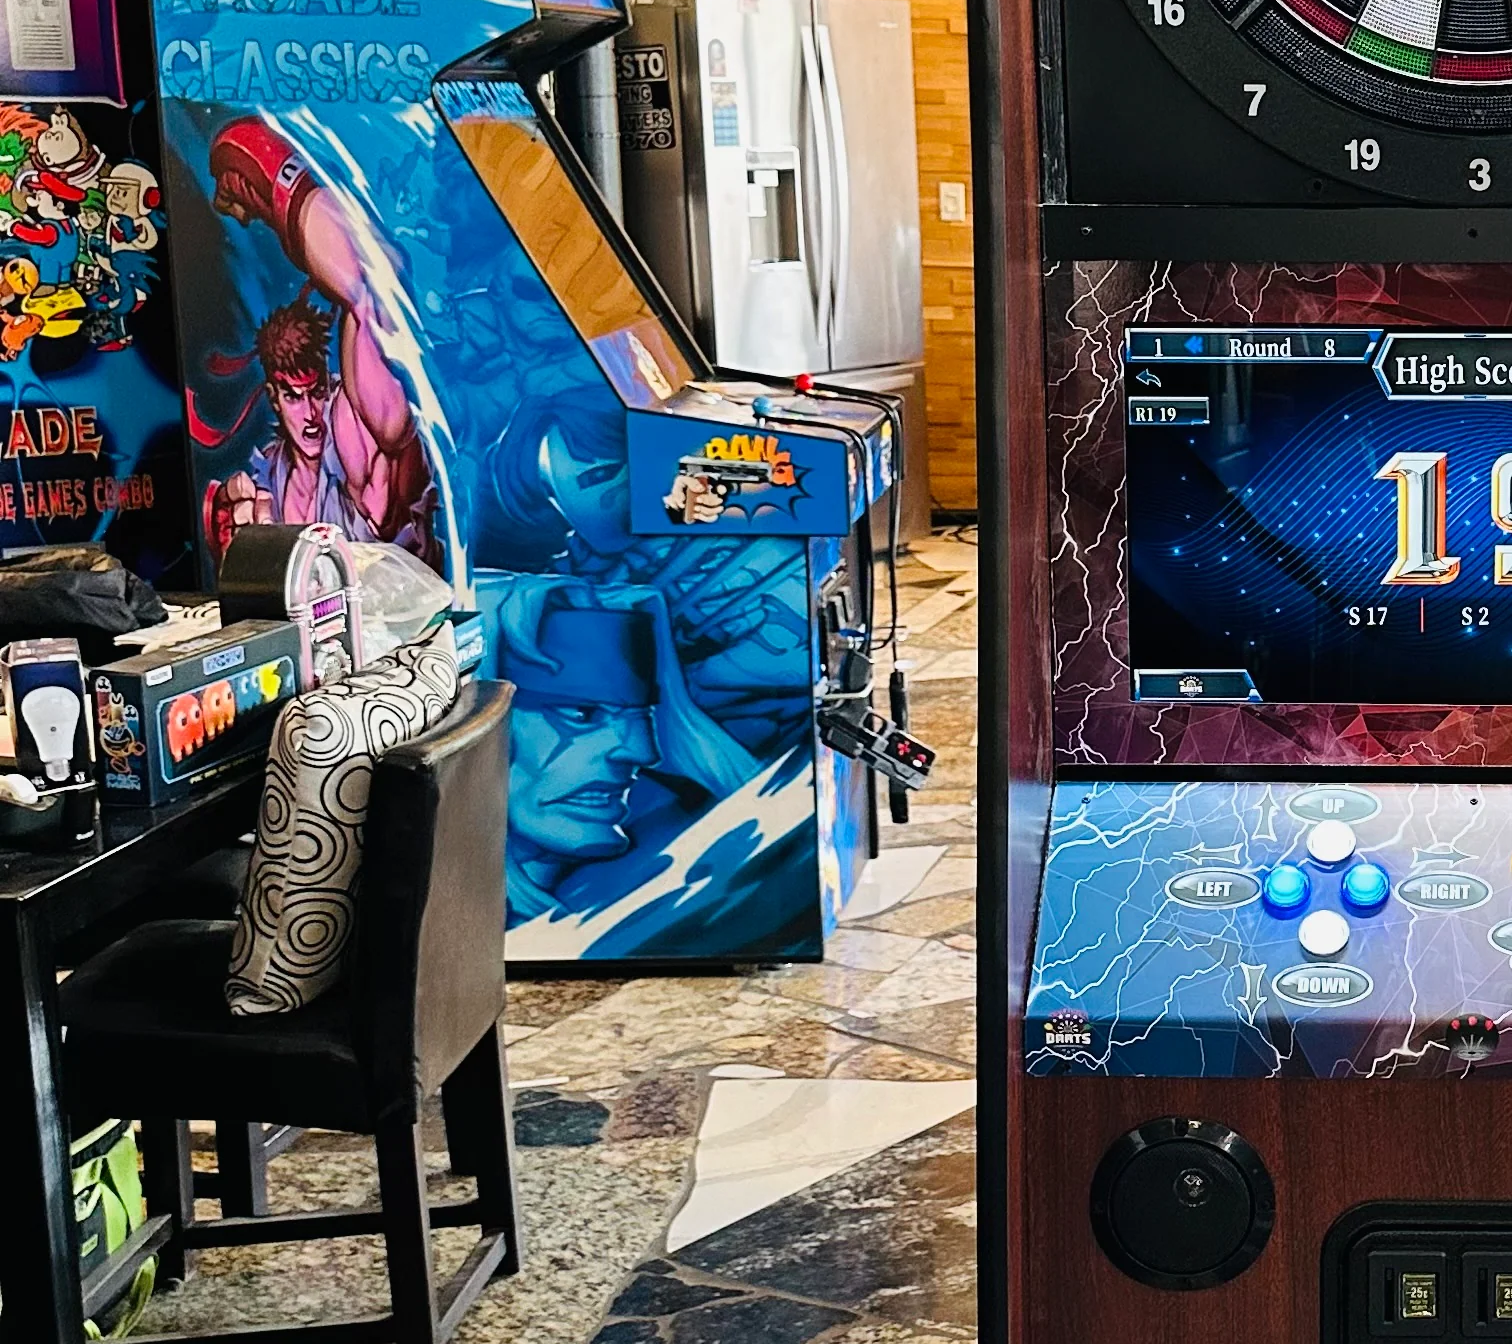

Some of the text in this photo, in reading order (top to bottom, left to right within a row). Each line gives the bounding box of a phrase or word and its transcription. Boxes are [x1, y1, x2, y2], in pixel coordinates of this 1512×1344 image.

[161, 39, 435, 103] CLASSICS
[1243, 84, 1267, 117] 7
[1344, 138, 1381, 171] 19
[1468, 158, 1491, 192] 3
[1153, 338, 1164, 357] 1
[1228, 338, 1336, 358] Round 8
[1395, 356, 1465, 393] High
[1159, 408, 1177, 423] 19
[0, 406, 103, 462] ADE
[22, 479, 88, 525] GAMES
[1348, 606, 1388, 626] S 17
[1461, 606, 1490, 626] S 2
[1322, 798, 1345, 814] UP
[1196, 879, 1232, 899] LEFT
[1420, 884, 1471, 900] RIGHT
[1297, 976, 1350, 994] DOWN
[1045, 1032, 1091, 1045] DARTS
